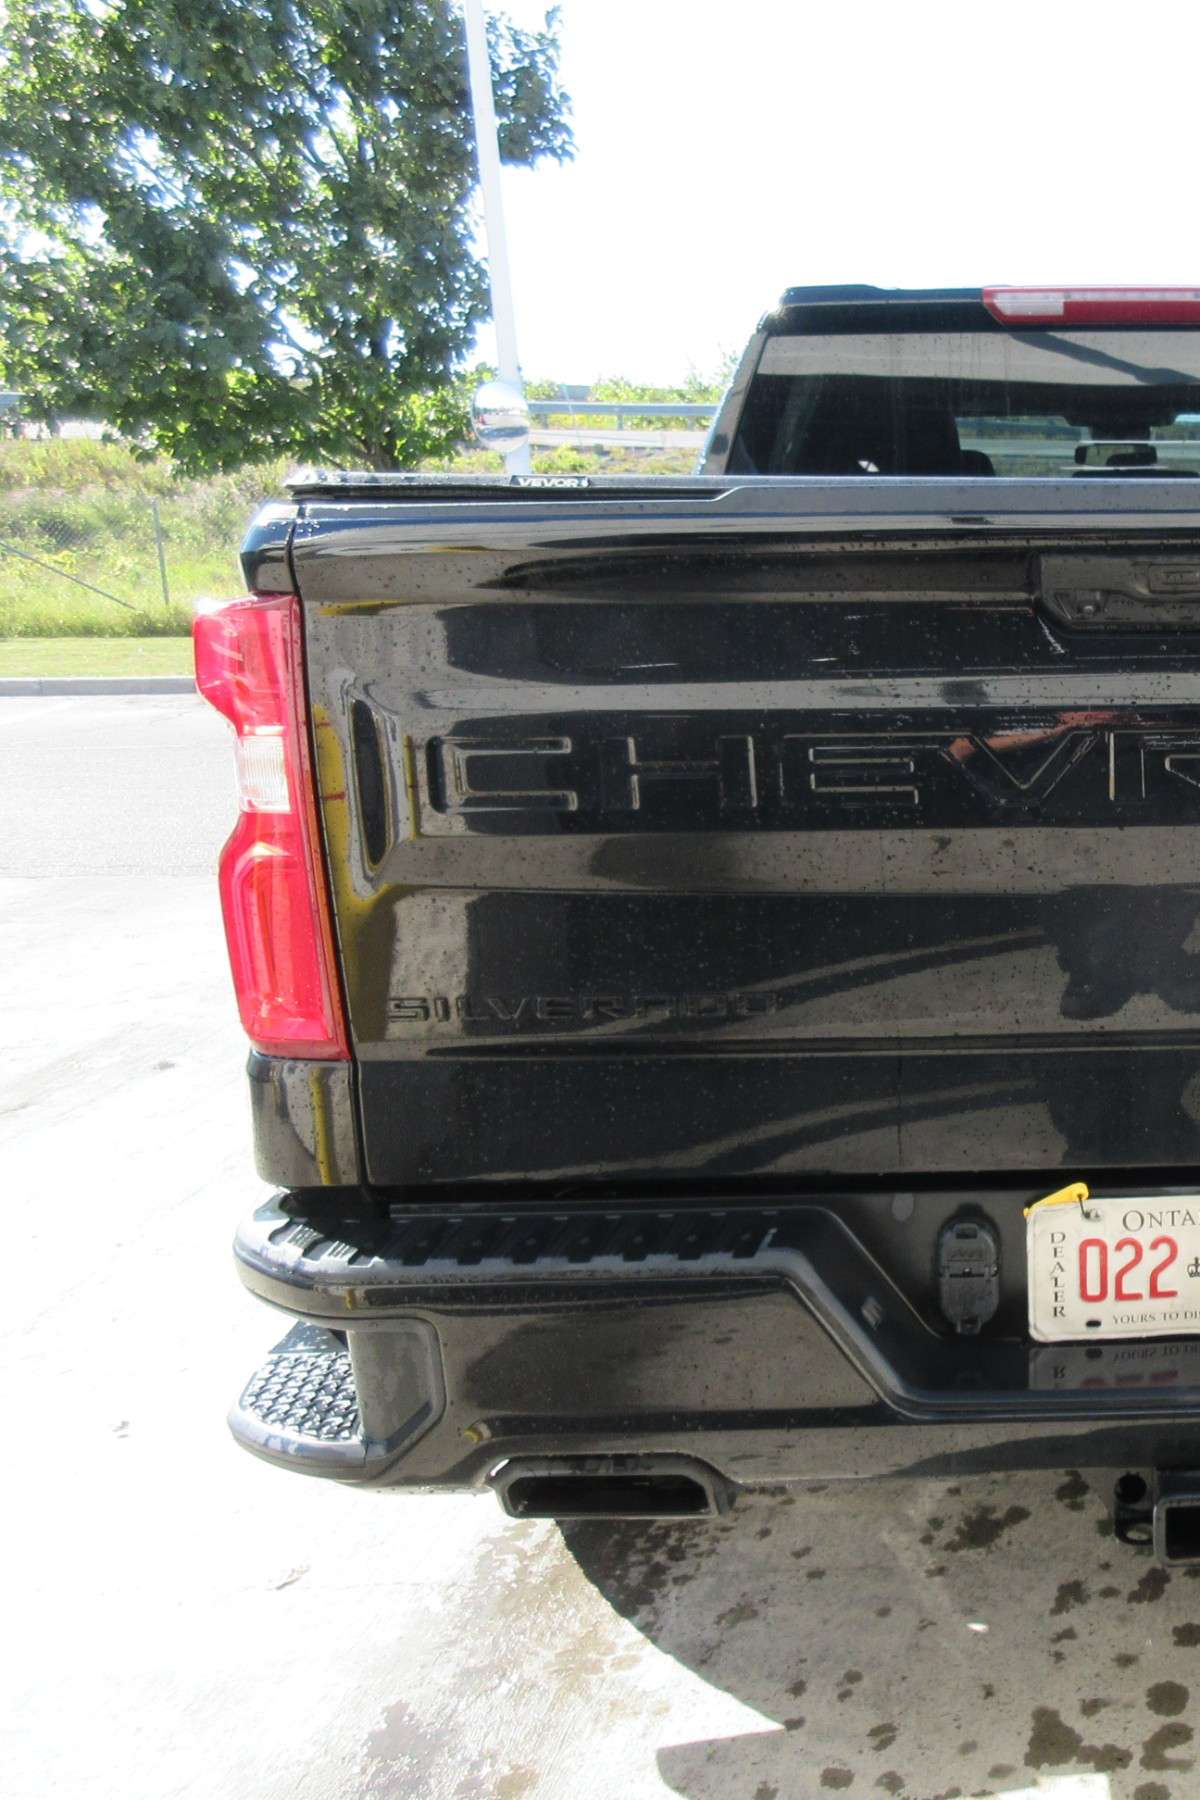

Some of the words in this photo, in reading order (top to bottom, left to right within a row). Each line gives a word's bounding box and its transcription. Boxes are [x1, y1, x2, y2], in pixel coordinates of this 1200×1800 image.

[518, 477, 577, 487] VEVOR
[386, 992, 779, 1024] SILVERADO
[1049, 1231, 1067, 1319] DEALER
[1077, 1234, 1179, 1304] 022
[1112, 1313, 1156, 1325] YOURS
[1161, 1311, 1179, 1321] TO
